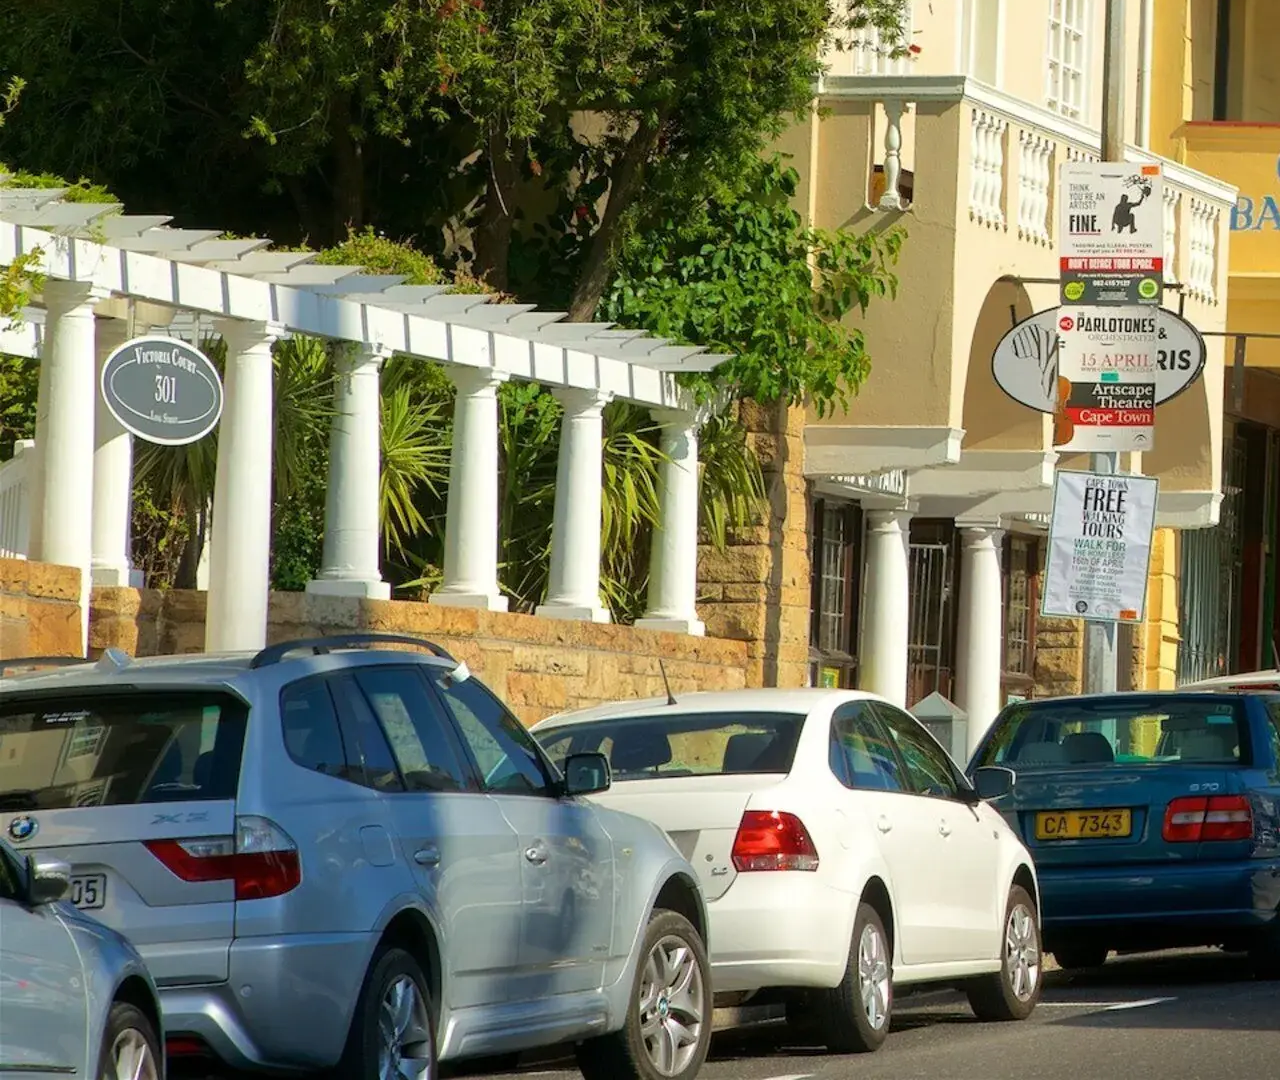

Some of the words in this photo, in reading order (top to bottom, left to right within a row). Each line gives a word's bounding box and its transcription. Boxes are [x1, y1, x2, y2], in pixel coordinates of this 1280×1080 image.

[1069, 214, 1102, 232] FINE.
[1077, 317, 1155, 333] PARLOTONES
[1158, 327, 1168, 340] &
[135, 347, 171, 365] VICTORIA
[1081, 353, 1097, 367] 15
[1101, 353, 1155, 368] APRIL
[1157, 349, 1192, 371] RIS
[155, 375, 176, 404] 301
[1092, 383, 1153, 399] Artscape
[1097, 395, 1152, 409] Theatre
[1080, 409, 1113, 426] Cape
[1114, 410, 1151, 423] Town
[1083, 487, 1128, 513] FREE
[1082, 521, 1124, 538] TOURS
[1074, 539, 1102, 549] WALK
[1106, 541, 1126, 551] FOR
[1044, 816, 1068, 834] CA
[1078, 814, 1123, 833] 7343
[71, 879, 98, 906] 05
